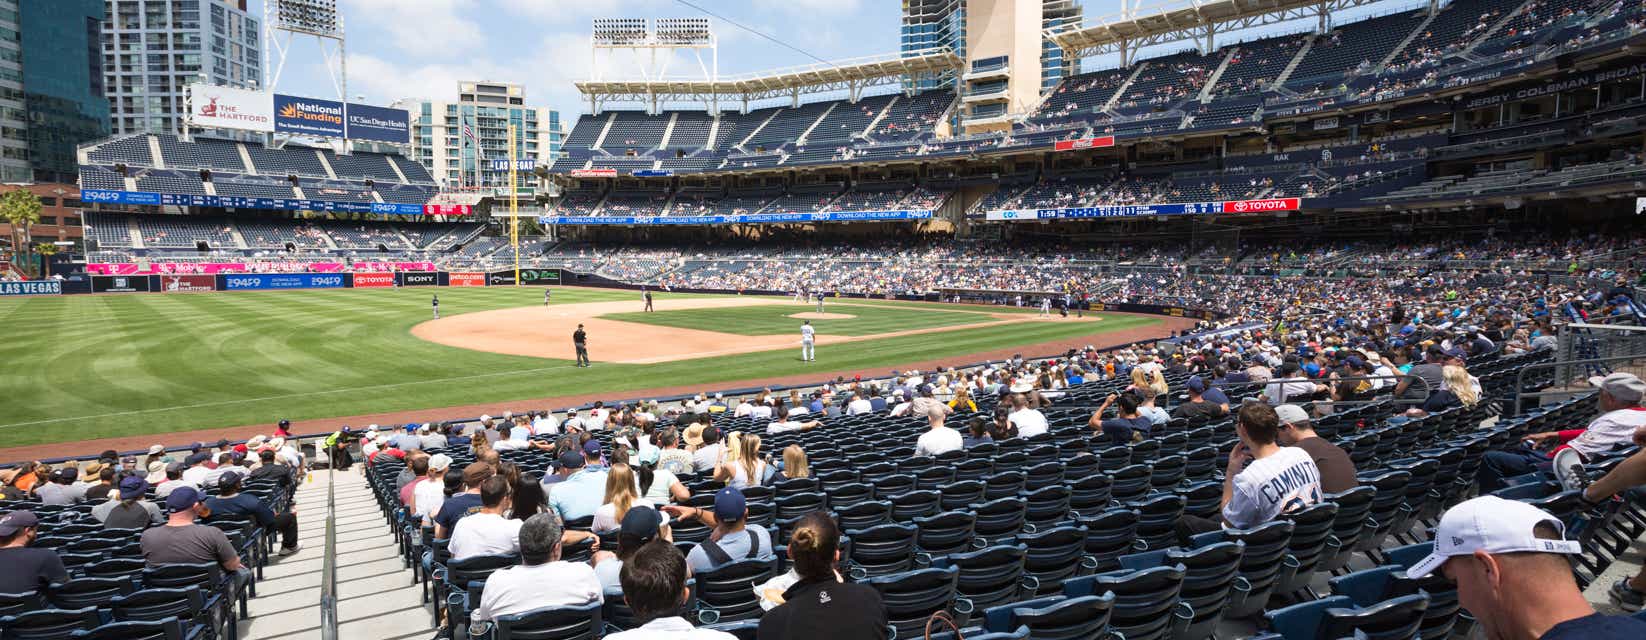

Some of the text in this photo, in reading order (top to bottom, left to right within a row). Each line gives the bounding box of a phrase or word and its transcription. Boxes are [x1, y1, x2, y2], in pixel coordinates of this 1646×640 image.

[1466, 93, 1511, 108] JERRY
[1516, 76, 1589, 98] COLEMAN
[220, 104, 240, 113] THE
[296, 102, 342, 115] National
[219, 113, 268, 123] HARTFORD
[296, 110, 342, 125] Funding
[350, 115, 360, 123] UC
[360, 116, 371, 125] San
[388, 120, 407, 128] Health
[1274, 153, 1289, 161] RAK
[495, 161, 508, 170] LAS
[1249, 201, 1286, 209] TOYOTA
[450, 273, 484, 281] petco.com
[0, 282, 59, 293] LAS VEGAS
[1261, 461, 1318, 504] CAMINIT
